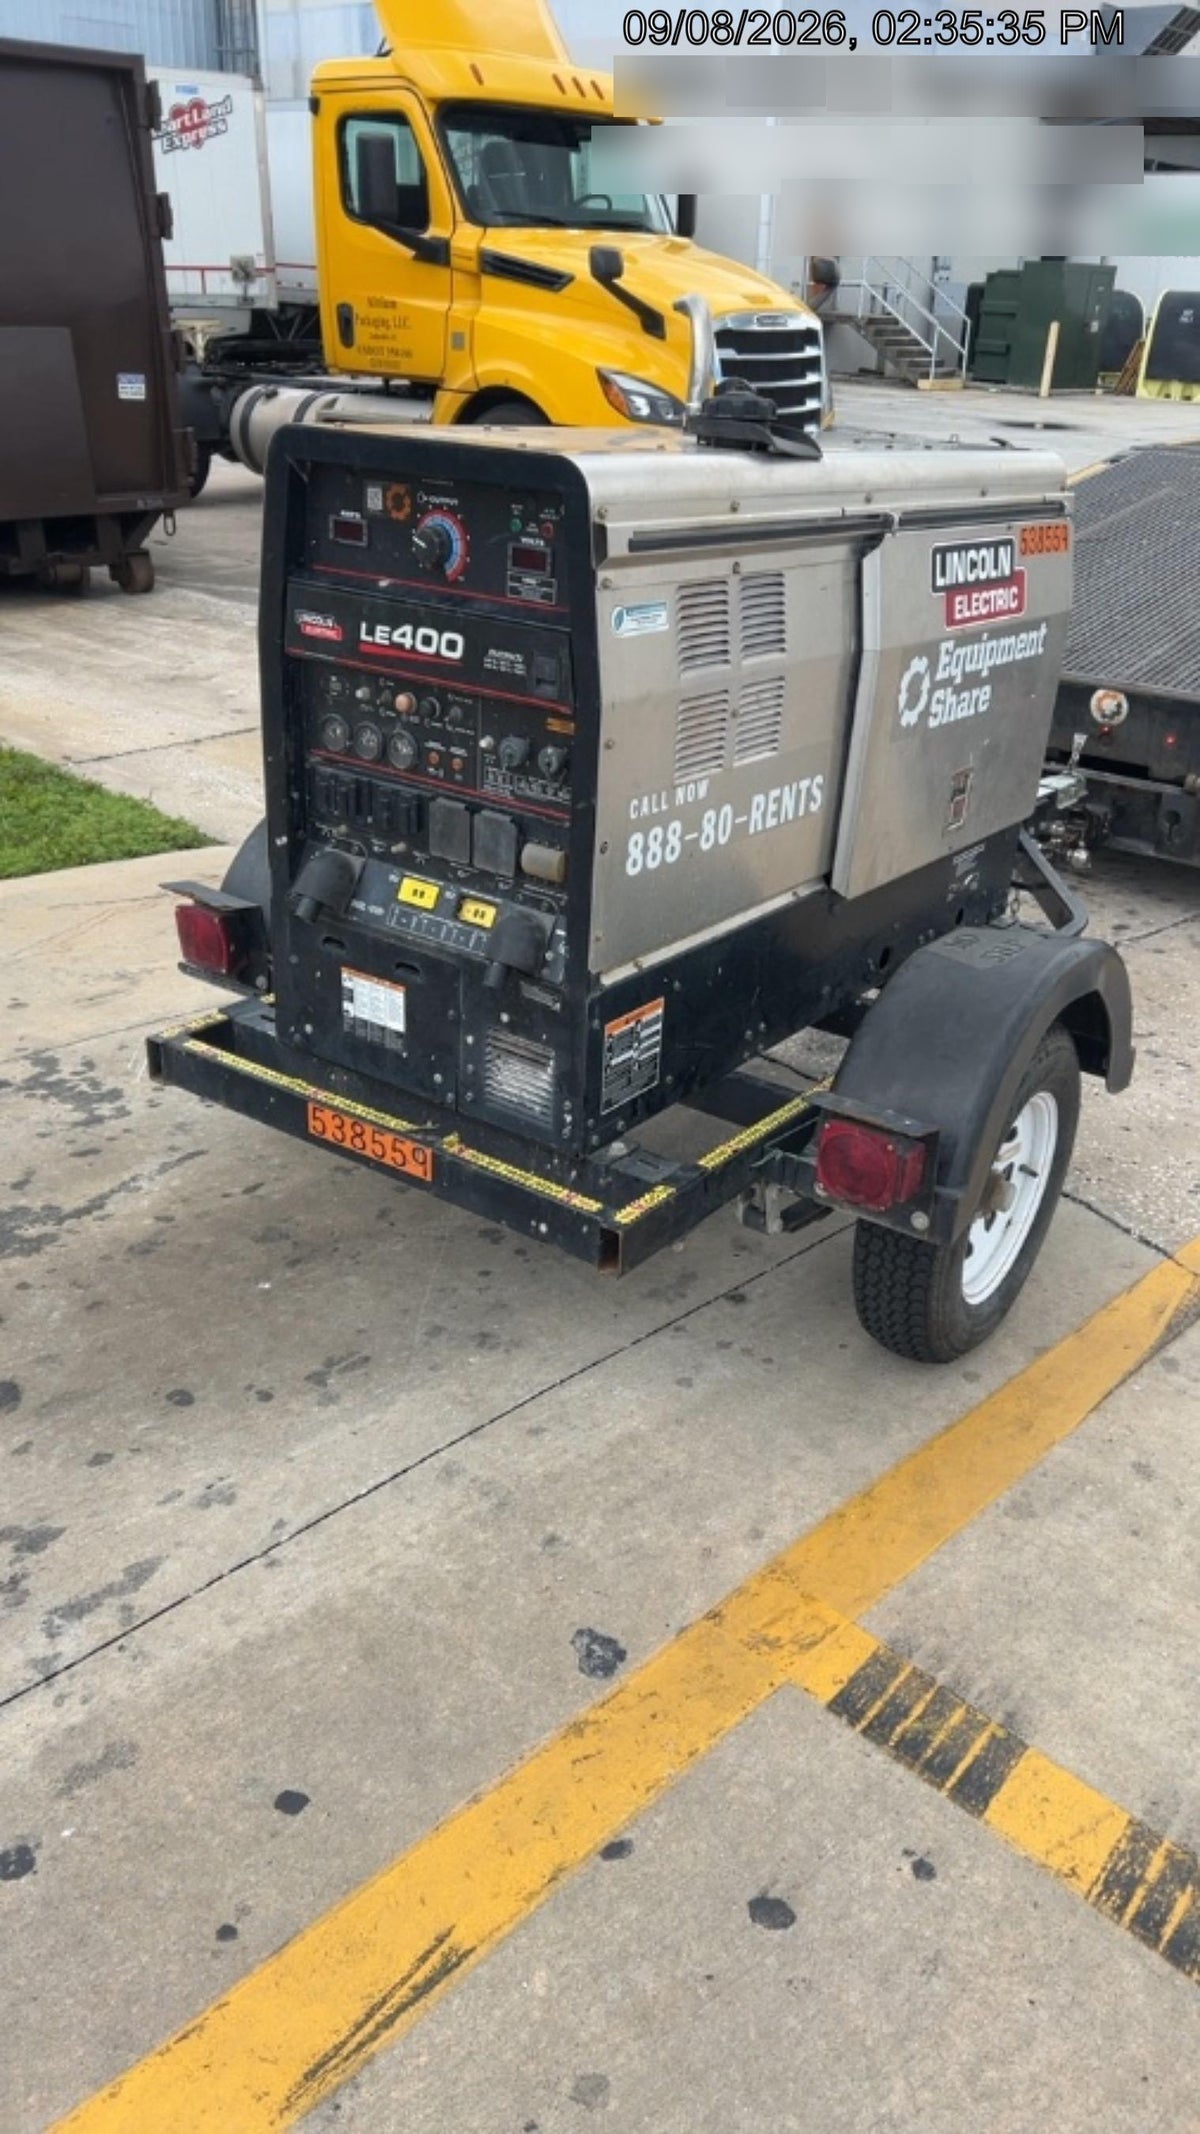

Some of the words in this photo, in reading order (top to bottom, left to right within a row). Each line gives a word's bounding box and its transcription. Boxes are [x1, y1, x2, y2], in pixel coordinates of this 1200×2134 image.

[152, 95, 232, 139] eartLand
[162, 118, 228, 154] Express
[1020, 523, 1068, 556] 538559
[936, 544, 1012, 588] LINCOLN
[954, 586, 1019, 620] ELECTRIC
[360, 621, 464, 660] LE400
[934, 621, 1048, 684] Equipment
[928, 684, 992, 728] Share
[629, 791, 669, 819] CALL
[675, 778, 710, 806] NOW
[625, 774, 824, 876] 888-80-RENTS
[312, 1106, 428, 1178] 538559
